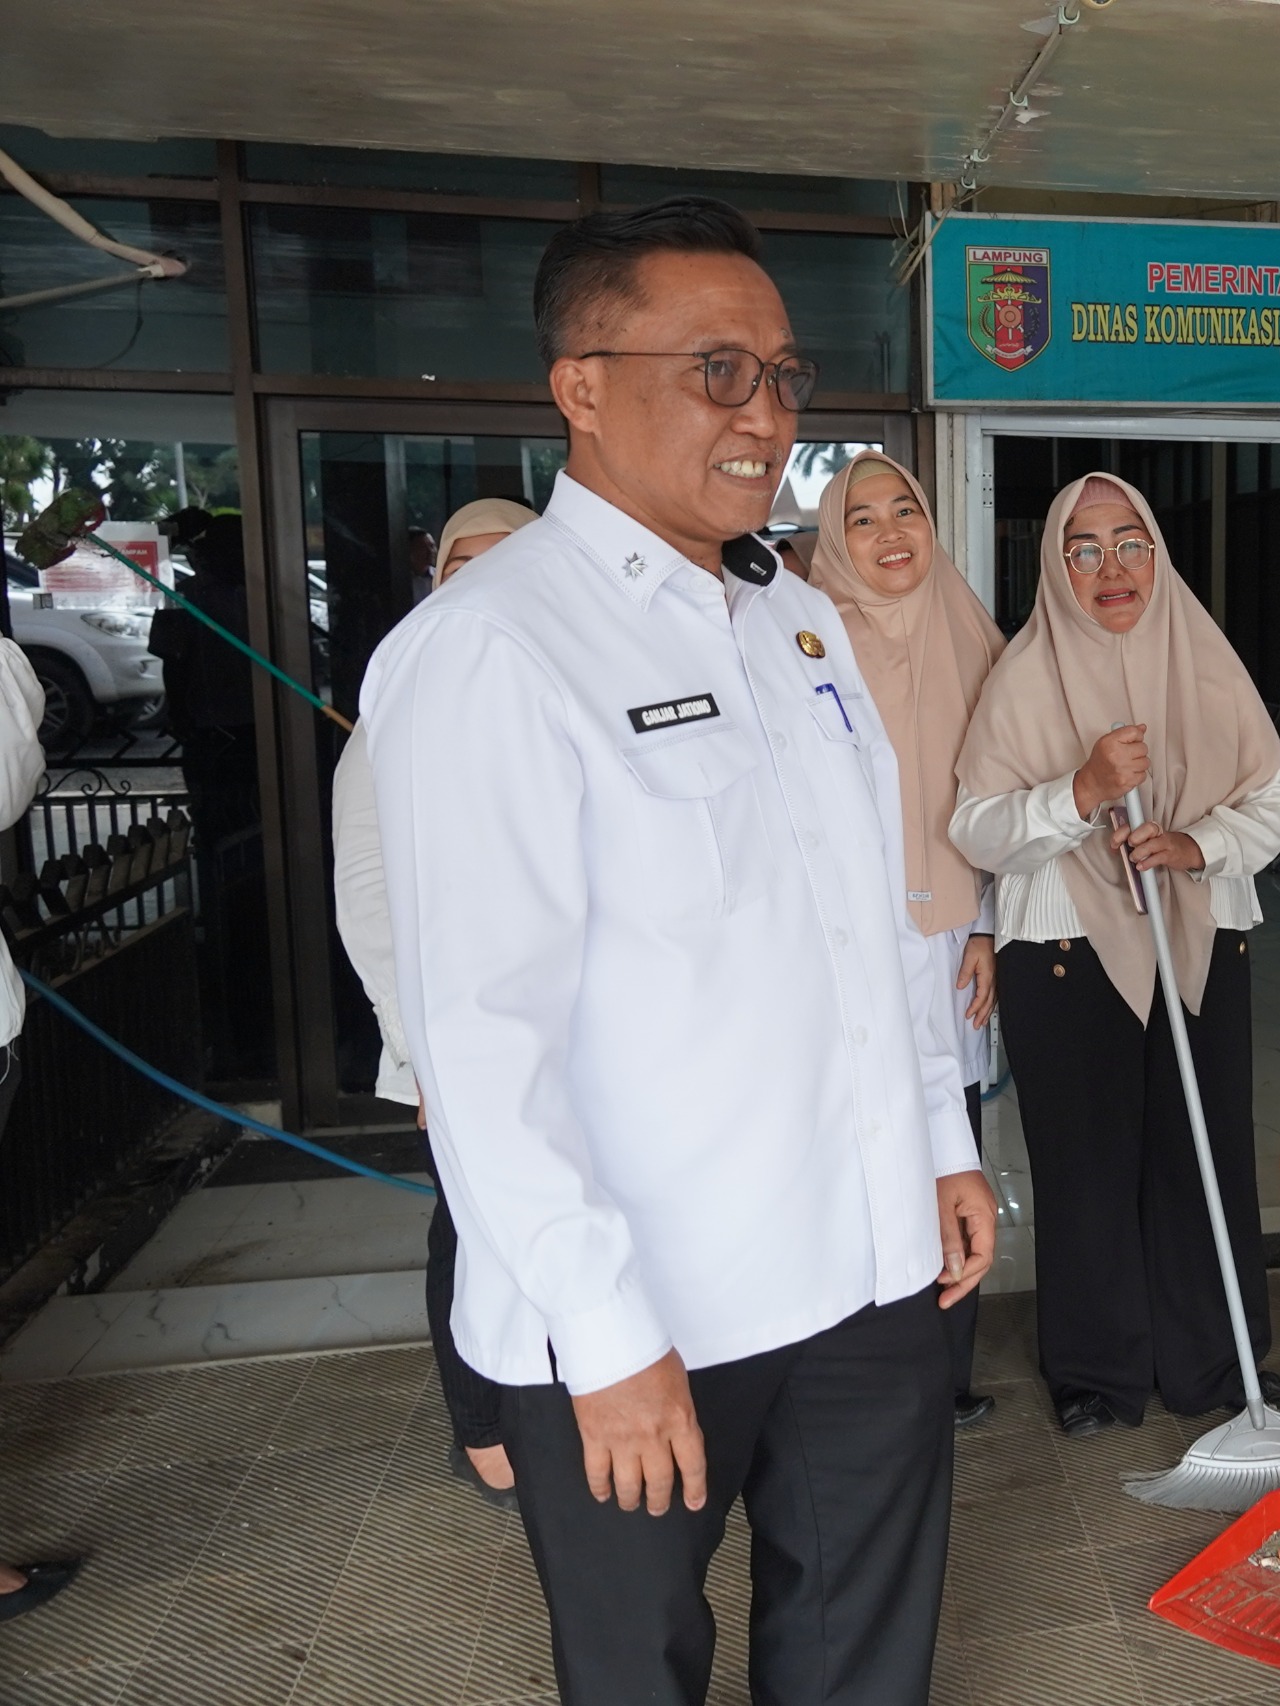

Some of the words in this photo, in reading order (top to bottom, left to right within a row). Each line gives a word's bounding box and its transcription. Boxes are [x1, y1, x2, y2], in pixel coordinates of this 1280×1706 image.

[972, 250, 1043, 263] LAMPUNG
[1071, 302, 1138, 343] DINAS
[642, 706, 678, 726] GANJAR
